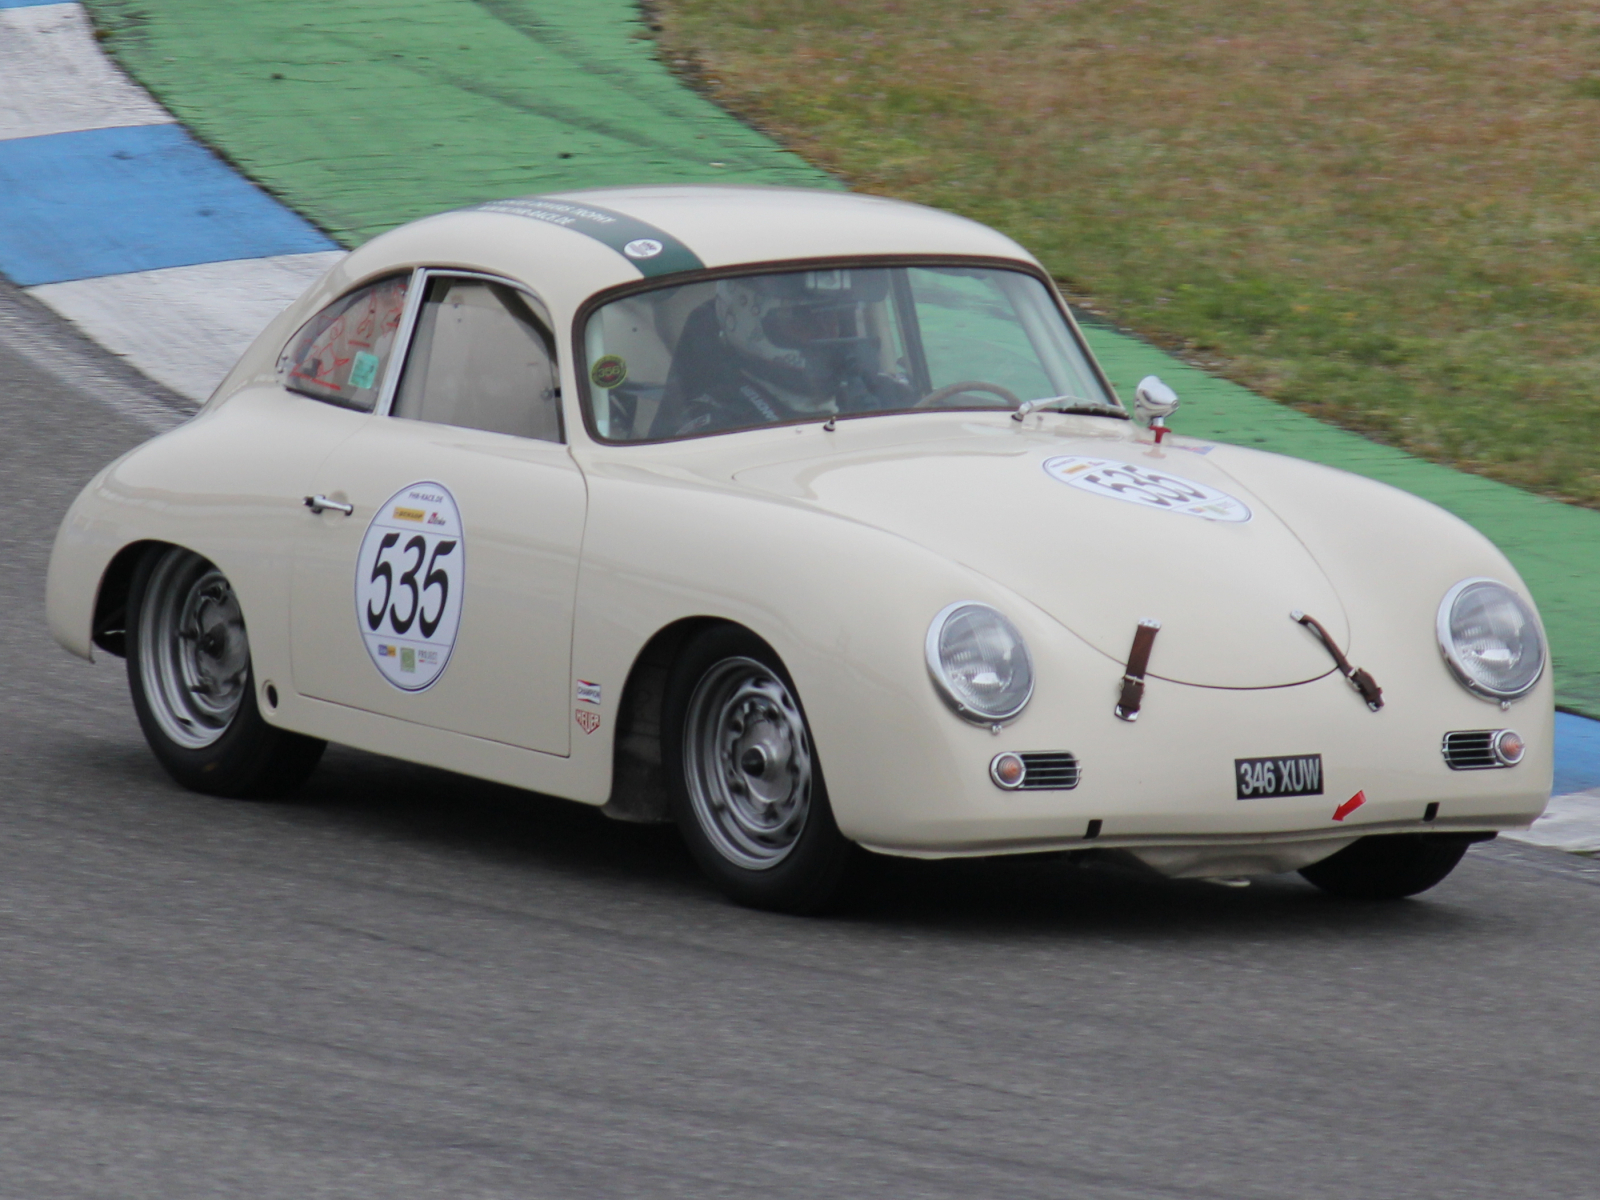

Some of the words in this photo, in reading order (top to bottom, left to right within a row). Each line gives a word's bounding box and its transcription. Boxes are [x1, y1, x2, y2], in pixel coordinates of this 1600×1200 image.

[1084, 465, 1207, 507] 535
[366, 532, 457, 639] 535
[575, 709, 600, 734] HEUER
[1240, 760, 1276, 795] 346
[1278, 758, 1320, 793] XUW
